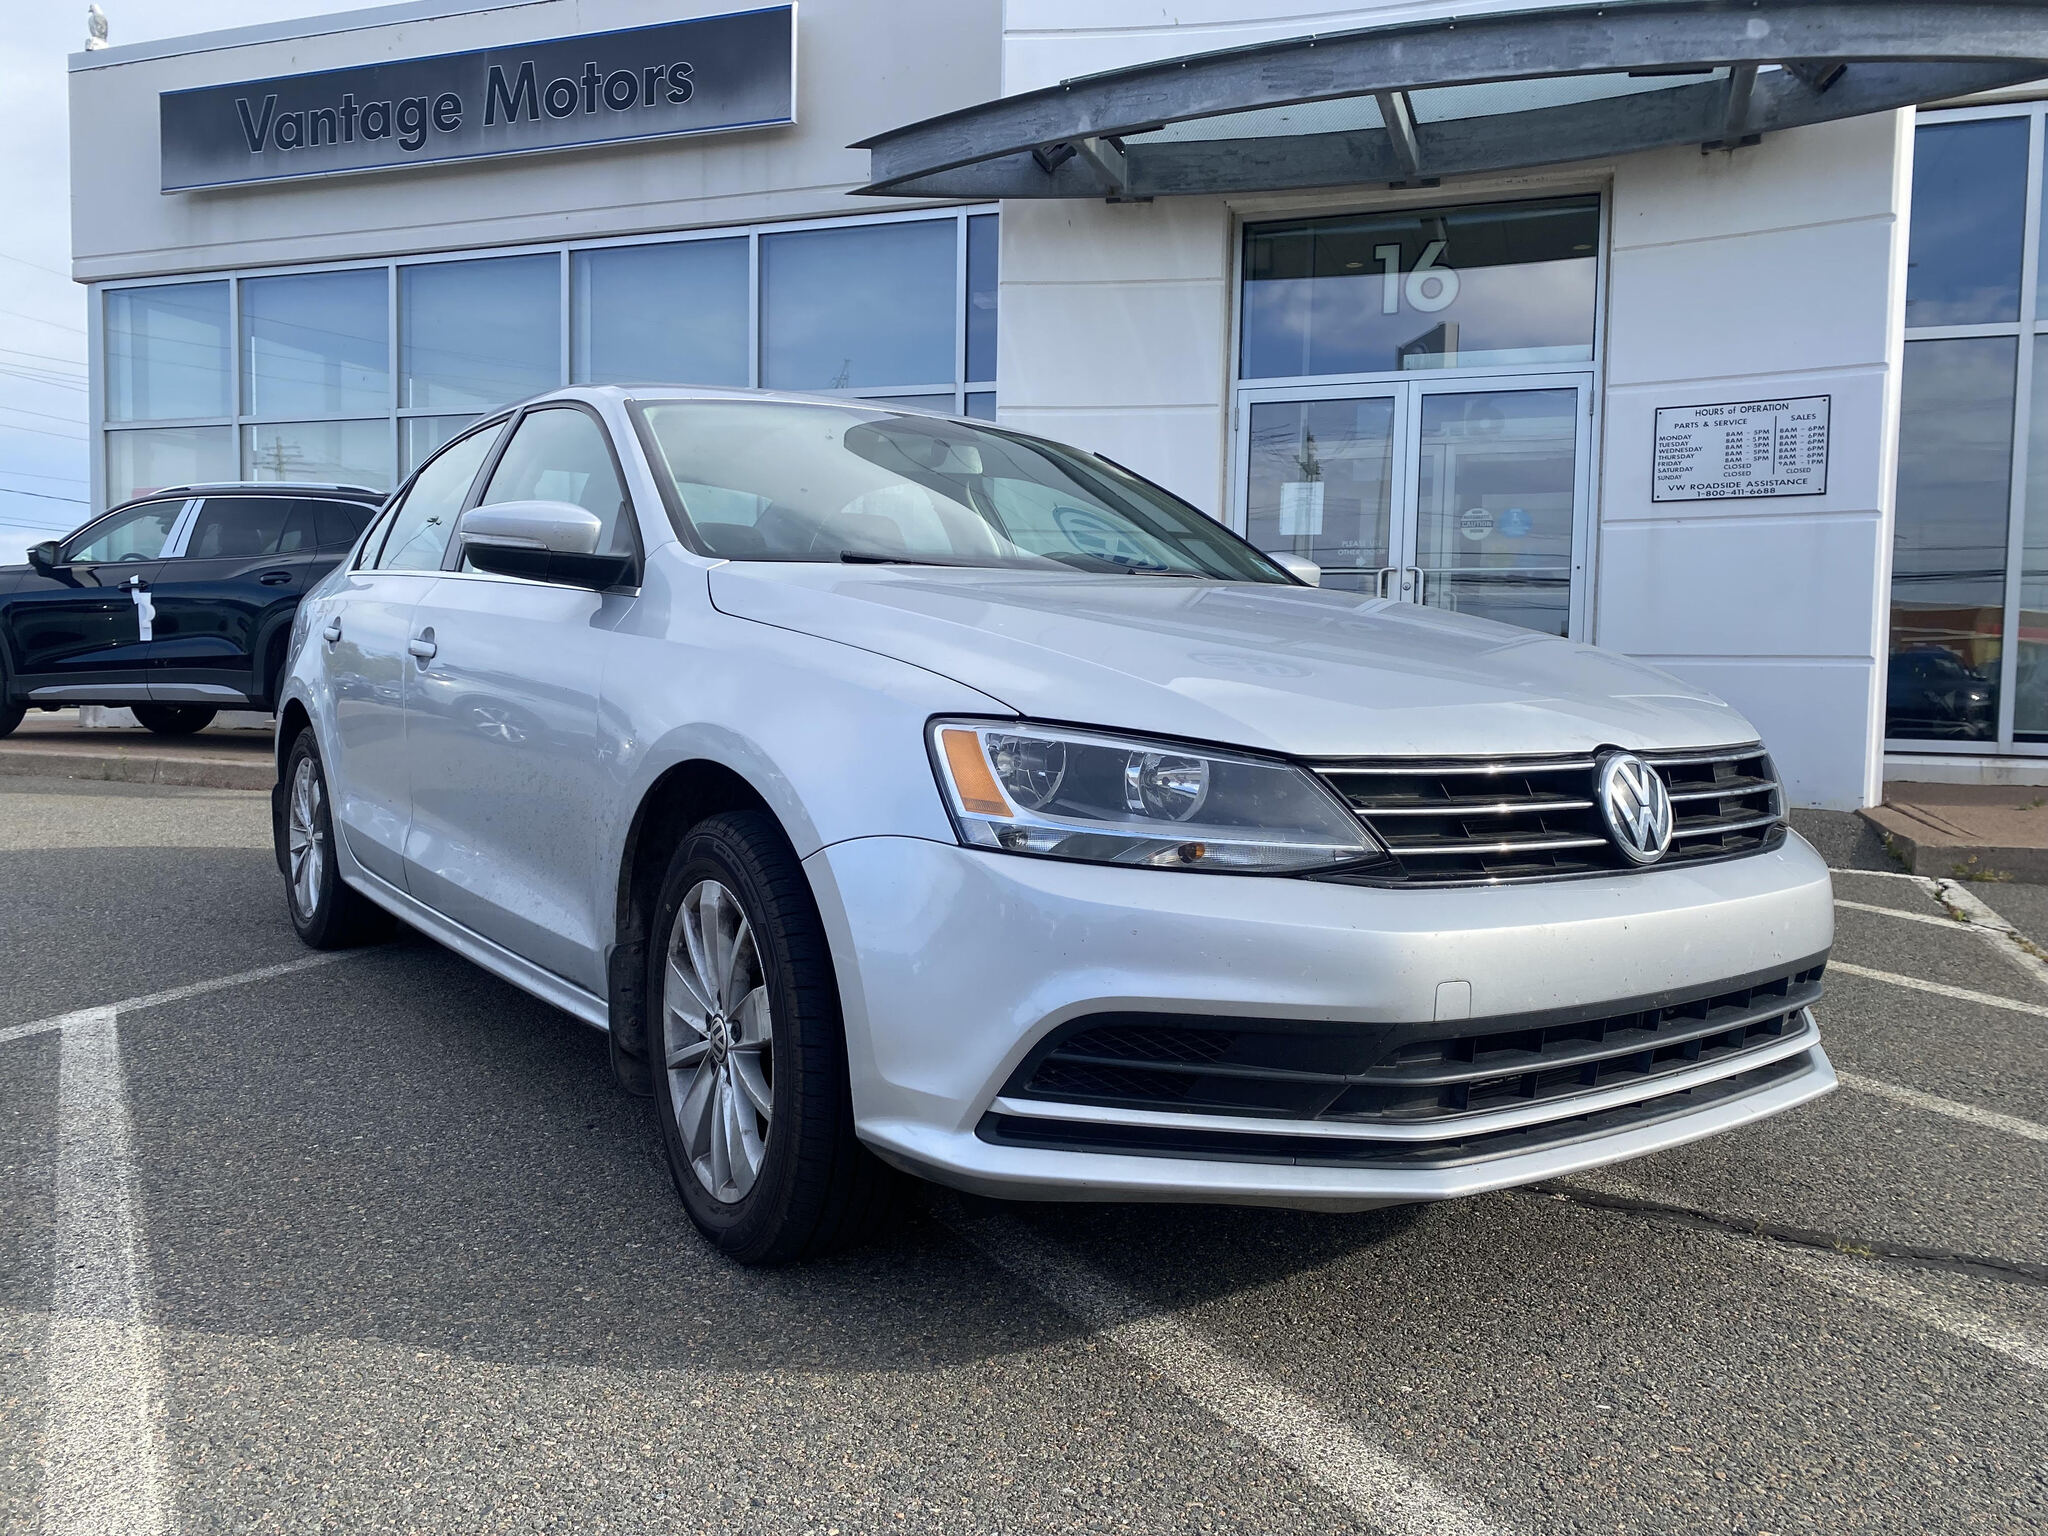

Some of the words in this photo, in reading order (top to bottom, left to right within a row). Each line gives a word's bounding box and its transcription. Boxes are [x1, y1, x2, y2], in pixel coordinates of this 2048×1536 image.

[234, 91, 464, 153] Vantage
[482, 60, 695, 127] Motors
[1374, 240, 1460, 314] 16
[1695, 408, 1724, 416] HOURS
[1728, 406, 1736, 414] of
[1740, 402, 1790, 414] OPERATION
[1714, 418, 1748, 426] SERVICE
[1690, 481, 1742, 490] ROADSIDE
[1746, 478, 1808, 487] ASSISTANCE
[1697, 488, 1776, 497] 1-800-411-6688
